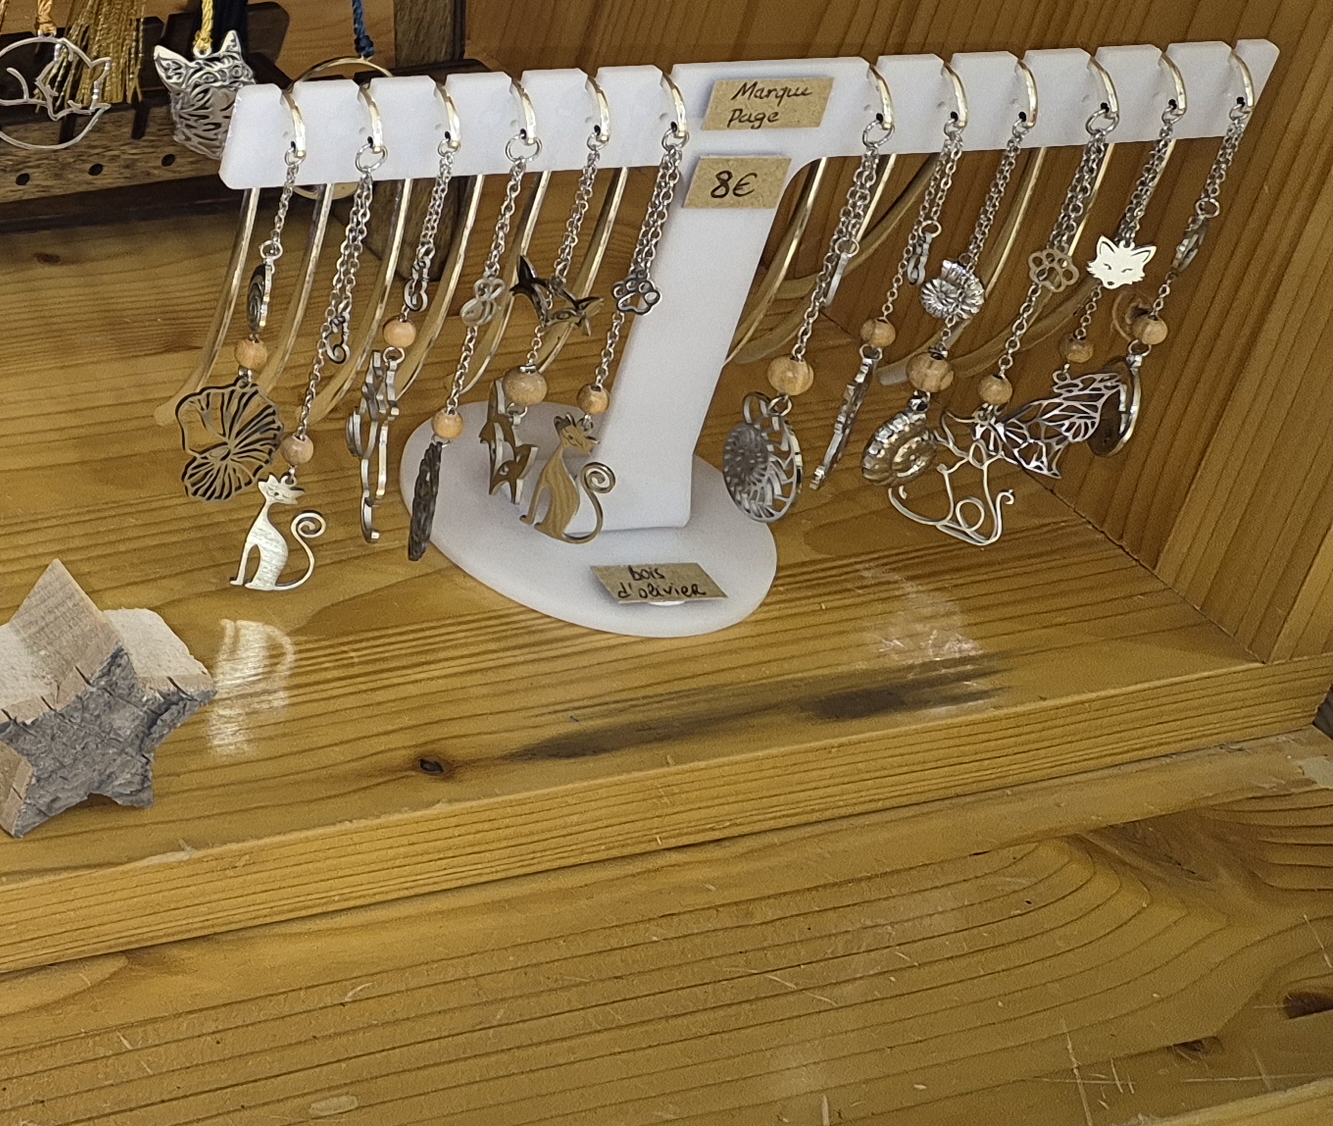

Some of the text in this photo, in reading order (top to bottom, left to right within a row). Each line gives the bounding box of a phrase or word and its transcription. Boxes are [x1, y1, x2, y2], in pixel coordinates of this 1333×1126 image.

[731, 80, 813, 108] Marque
[726, 108, 780, 130] Page
[709, 169, 758, 199] 8€
[628, 564, 666, 582] bois
[617, 581, 707, 600] d'olivier
